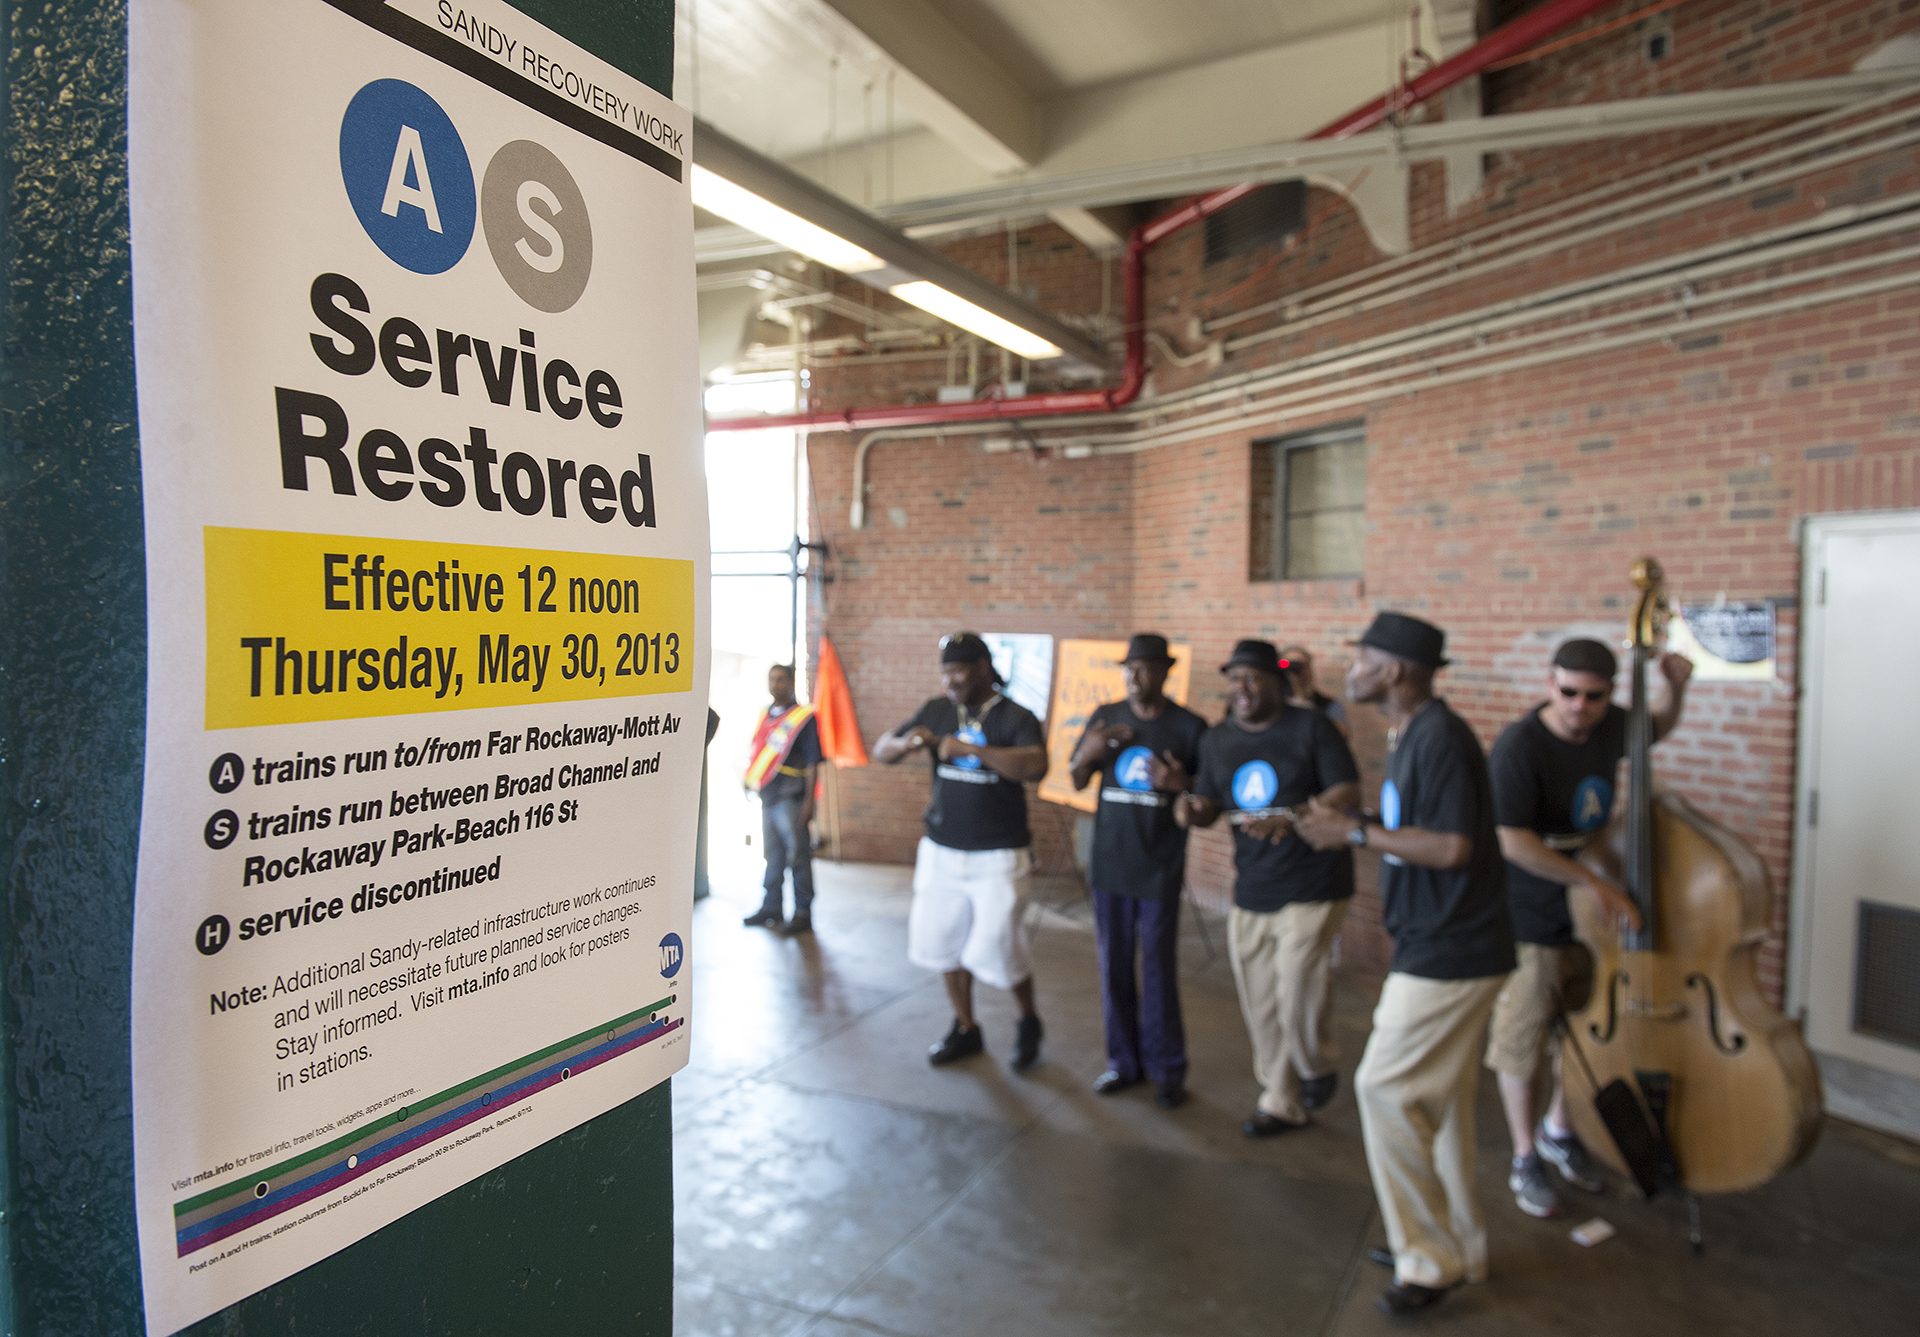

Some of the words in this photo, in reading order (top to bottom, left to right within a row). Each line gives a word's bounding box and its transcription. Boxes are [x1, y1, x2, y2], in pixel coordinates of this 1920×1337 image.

[437, 0, 517, 63] SANDY
[522, 45, 630, 123] RECOVERY
[633, 105, 684, 155] WORK
[380, 124, 444, 234] A
[513, 179, 565, 273] S
[309, 272, 623, 429] Service
[274, 385, 657, 529] Restored
[323, 552, 504, 613] Effective
[517, 564, 557, 613] 12
[568, 577, 640, 614] noon
[240, 635, 464, 699] Thursday,
[477, 633, 551, 693] May
[561, 632, 606, 686] 30,
[615, 632, 680, 677] 2013
[217, 761, 236, 785] A
[252, 751, 337, 786] trains
[343, 748, 388, 775] run
[393, 737, 482, 769] to/from
[487, 731, 522, 757] Far
[525, 715, 660, 752] Rockaway-Mott
[661, 712, 681, 735] Av
[1241, 771, 1267, 802] A
[212, 817, 231, 842] S
[248, 805, 332, 841] trains
[338, 798, 383, 826] run
[389, 783, 489, 818] between
[494, 767, 554, 800] Broad
[558, 756, 629, 789] Channel
[631, 752, 661, 777] and
[243, 839, 387, 887] Rockaway
[391, 810, 520, 858] Park-Beach
[524, 802, 554, 831] 116
[558, 799, 579, 824] St
[1582, 788, 1602, 822] A
[204, 922, 222, 947] H
[238, 896, 344, 941] service
[350, 855, 502, 914] discontinued
[209, 984, 267, 1015] Note:
[272, 952, 366, 998] Additional
[369, 921, 480, 968] Sandy-related
[483, 898, 571, 936] infrastructure
[573, 887, 602, 909] work
[604, 874, 656, 901] continues
[274, 999, 310, 1029] and
[314, 988, 343, 1016] will
[348, 962, 442, 1005] necessitate
[444, 947, 488, 975] future
[490, 927, 544, 964] planned
[546, 915, 590, 942] service
[593, 901, 642, 927] changes.
[275, 1032, 319, 1060] Stay
[323, 1000, 402, 1044] informed.
[411, 987, 444, 1012] Visit
[448, 966, 510, 1001] mta.info
[512, 956, 538, 978] and
[540, 946, 567, 969] look
[569, 941, 586, 959] for
[588, 926, 630, 956] posters
[659, 945, 680, 971] MTA
[277, 1071, 294, 1092] in
[299, 1044, 373, 1084] stations.
[171, 1178, 192, 1192] Visit
[193, 1162, 235, 1184] mta.info
[235, 1157, 249, 1168] for
[249, 1146, 273, 1163] travel
[274, 1140, 292, 1153] info,
[293, 1129, 315, 1146] travel
[315, 1122, 335, 1136] tools,
[337, 1109, 365, 1127] widgets,
[365, 1100, 383, 1116] apps
[383, 1093, 397, 1106] and
[188, 1260, 207, 1274] Post
[208, 1255, 219, 1266] on
[219, 1252, 226, 1261] A
[226, 1245, 242, 1258] and
[242, 1241, 249, 1250] H
[272, 1220, 297, 1237] station
[298, 1207, 327, 1225] columns
[327, 1198, 342, 1211] from
[342, 1188, 362, 1204] Euclid
[361, 1186, 370, 1195] Av
[369, 1182, 376, 1190] to
[376, 1177, 386, 1187] Far
[417, 1153, 435, 1166] Beach
[434, 1148, 442, 1158] 90
[442, 1145, 449, 1154] St
[449, 1143, 455, 1151] to
[455, 1131, 482, 1148] Rockaway
